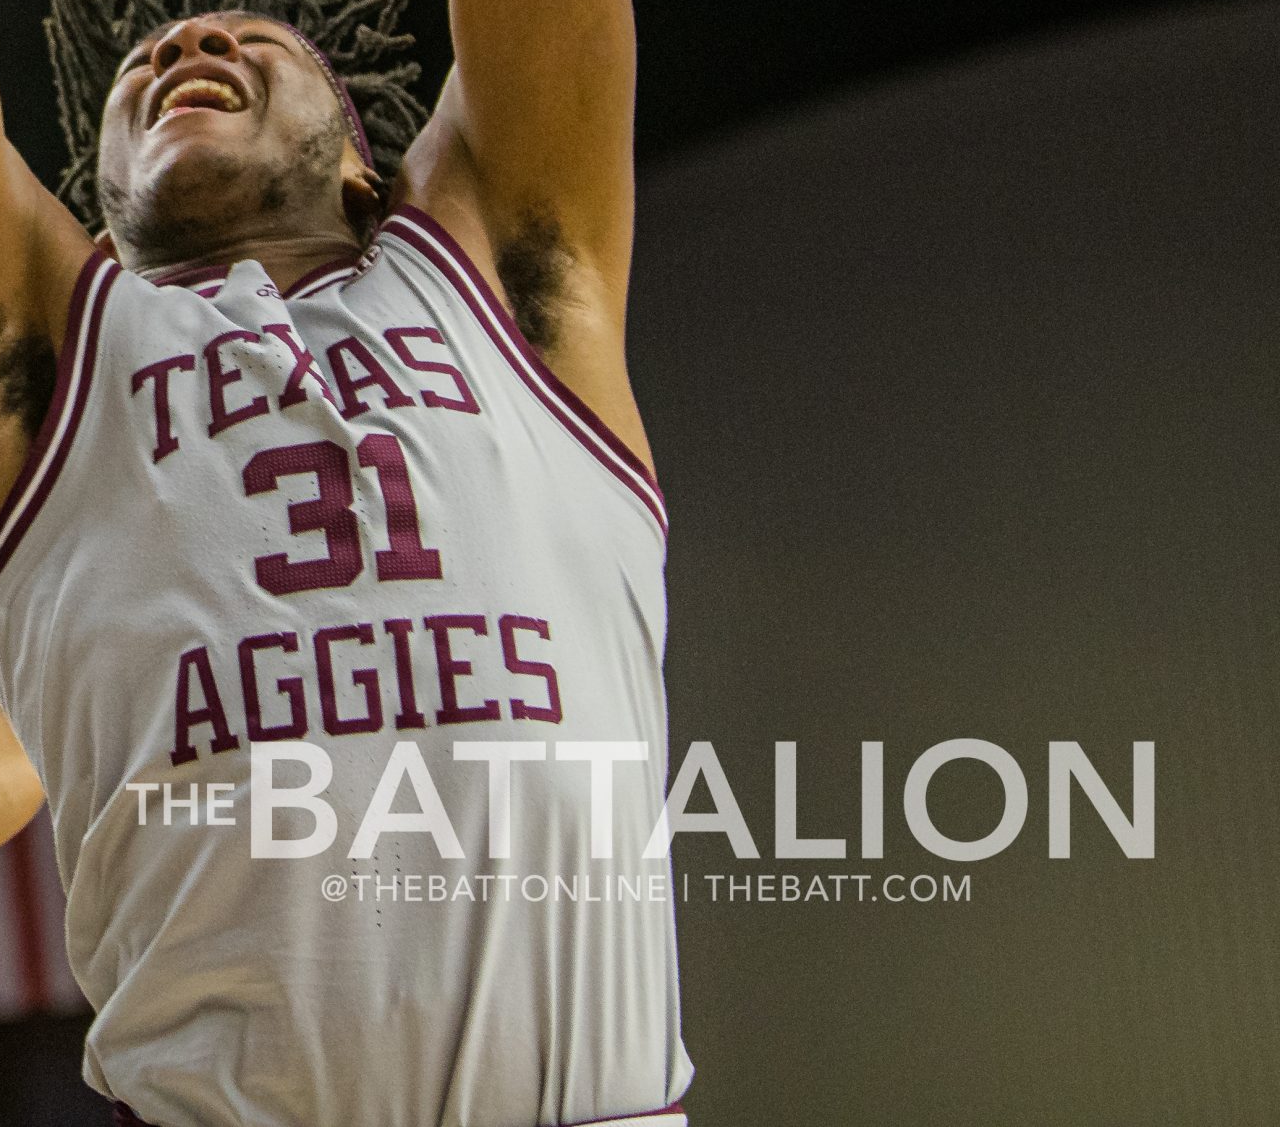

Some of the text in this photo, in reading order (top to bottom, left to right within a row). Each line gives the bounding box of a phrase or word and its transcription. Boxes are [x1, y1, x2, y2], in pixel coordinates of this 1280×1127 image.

[131, 323, 481, 464] TEXAS
[242, 433, 443, 596] 31
[169, 614, 564, 767] AGGIES
